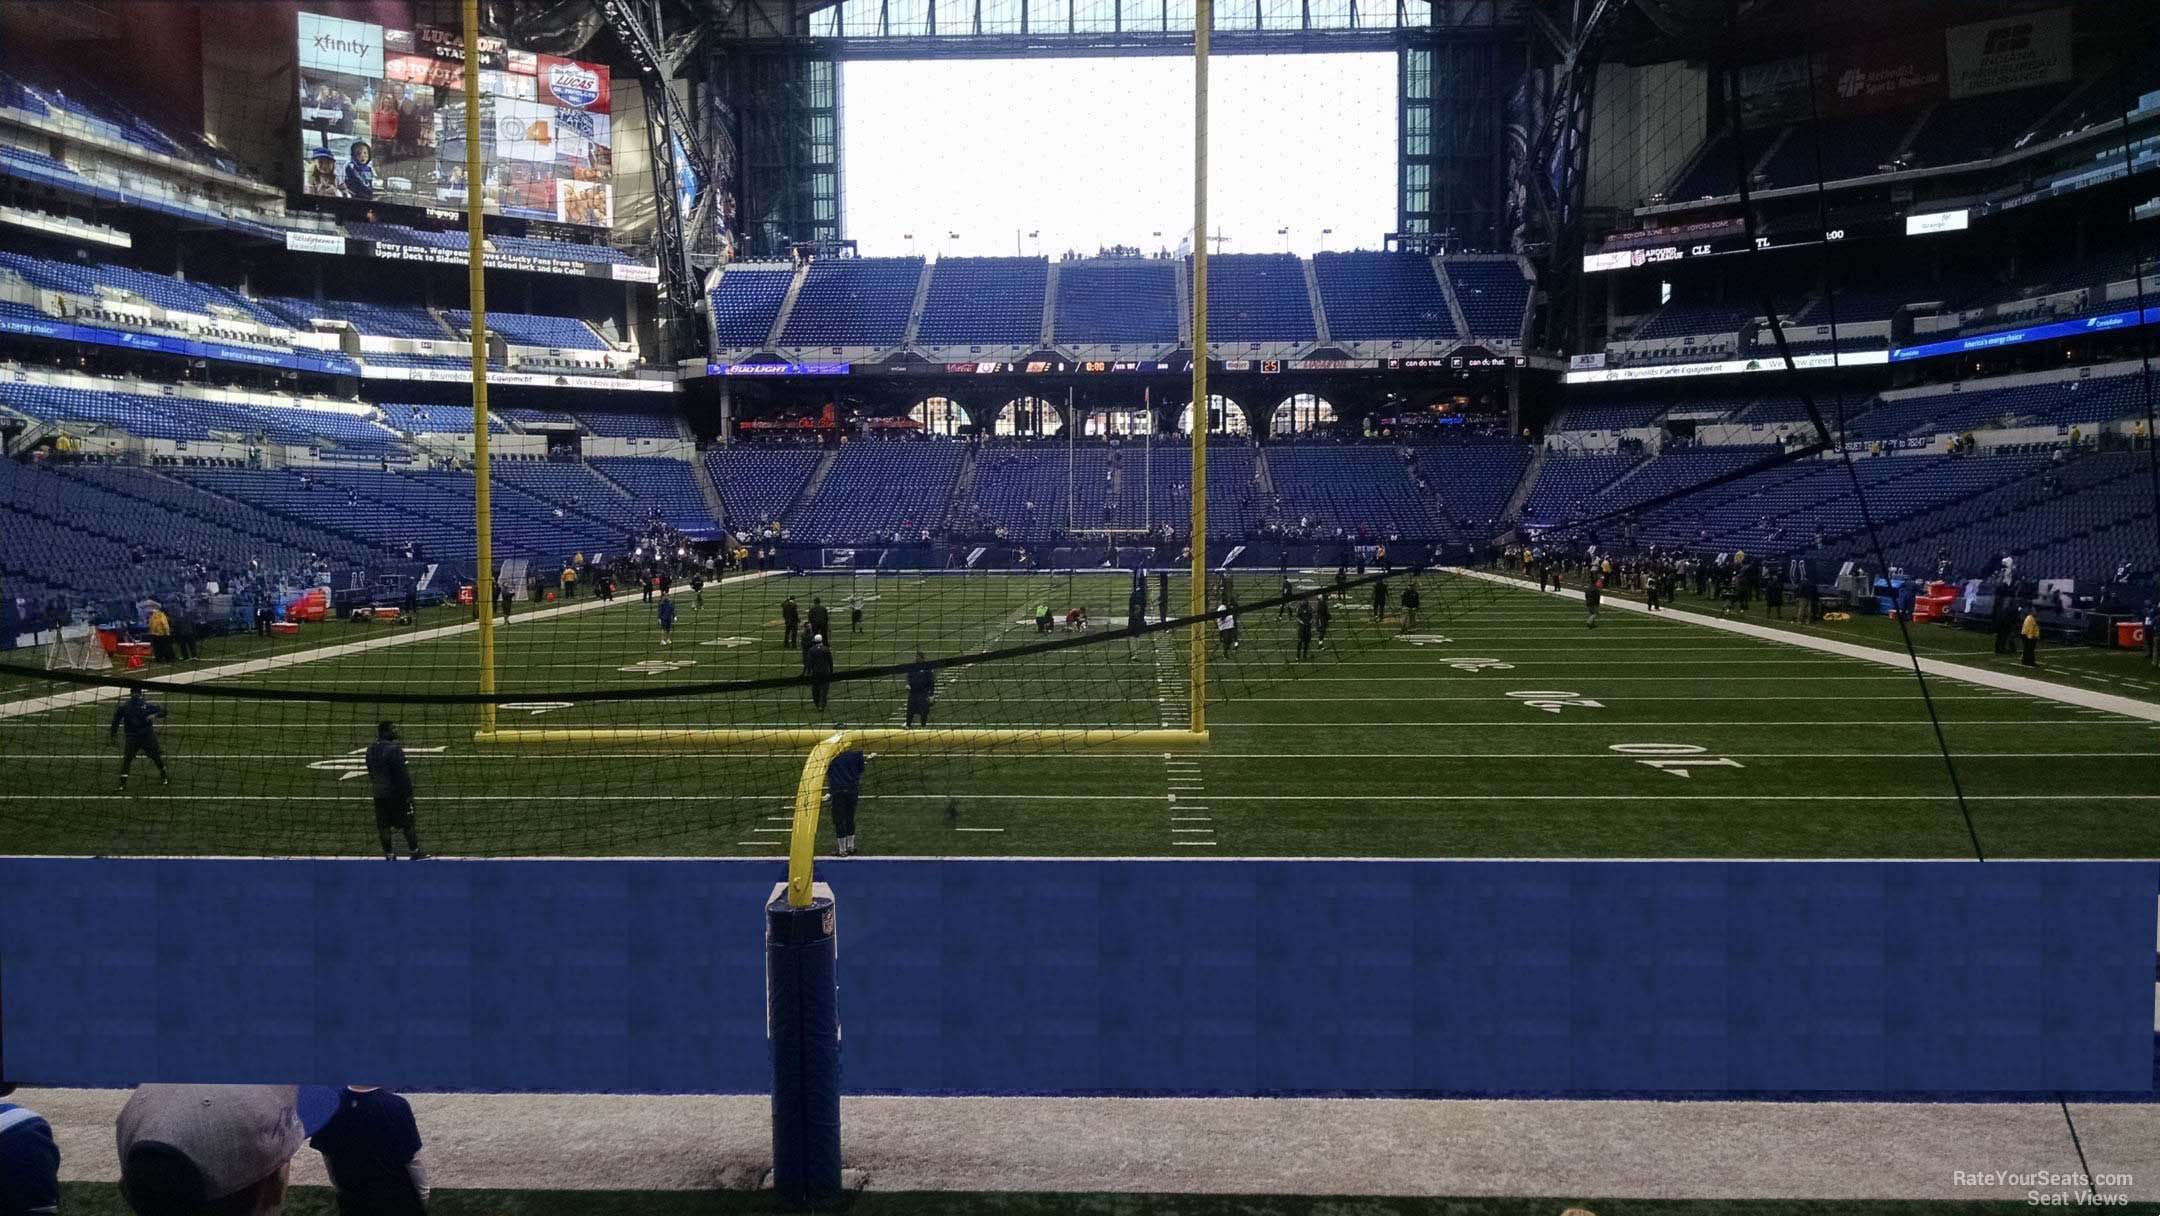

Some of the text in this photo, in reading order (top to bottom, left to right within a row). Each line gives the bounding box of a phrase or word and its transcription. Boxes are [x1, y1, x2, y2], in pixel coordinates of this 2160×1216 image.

[314, 34, 370, 58] xfinity
[436, 46, 490, 65] STADM
[556, 75, 594, 90] LUCAS
[376, 241, 401, 253] Every
[509, 254, 531, 265] Lucky
[553, 258, 570, 268] from
[1692, 245, 1711, 256] CLE
[1755, 237, 1770, 248] TL
[375, 249, 401, 260] Upper
[402, 252, 424, 262] Deck
[425, 253, 434, 262] to
[498, 260, 518, 270] Good
[537, 264, 551, 273] and
[552, 266, 563, 274] Go
[1264, 361, 1277, 371] 25
[2132, 629, 2144, 641] G
